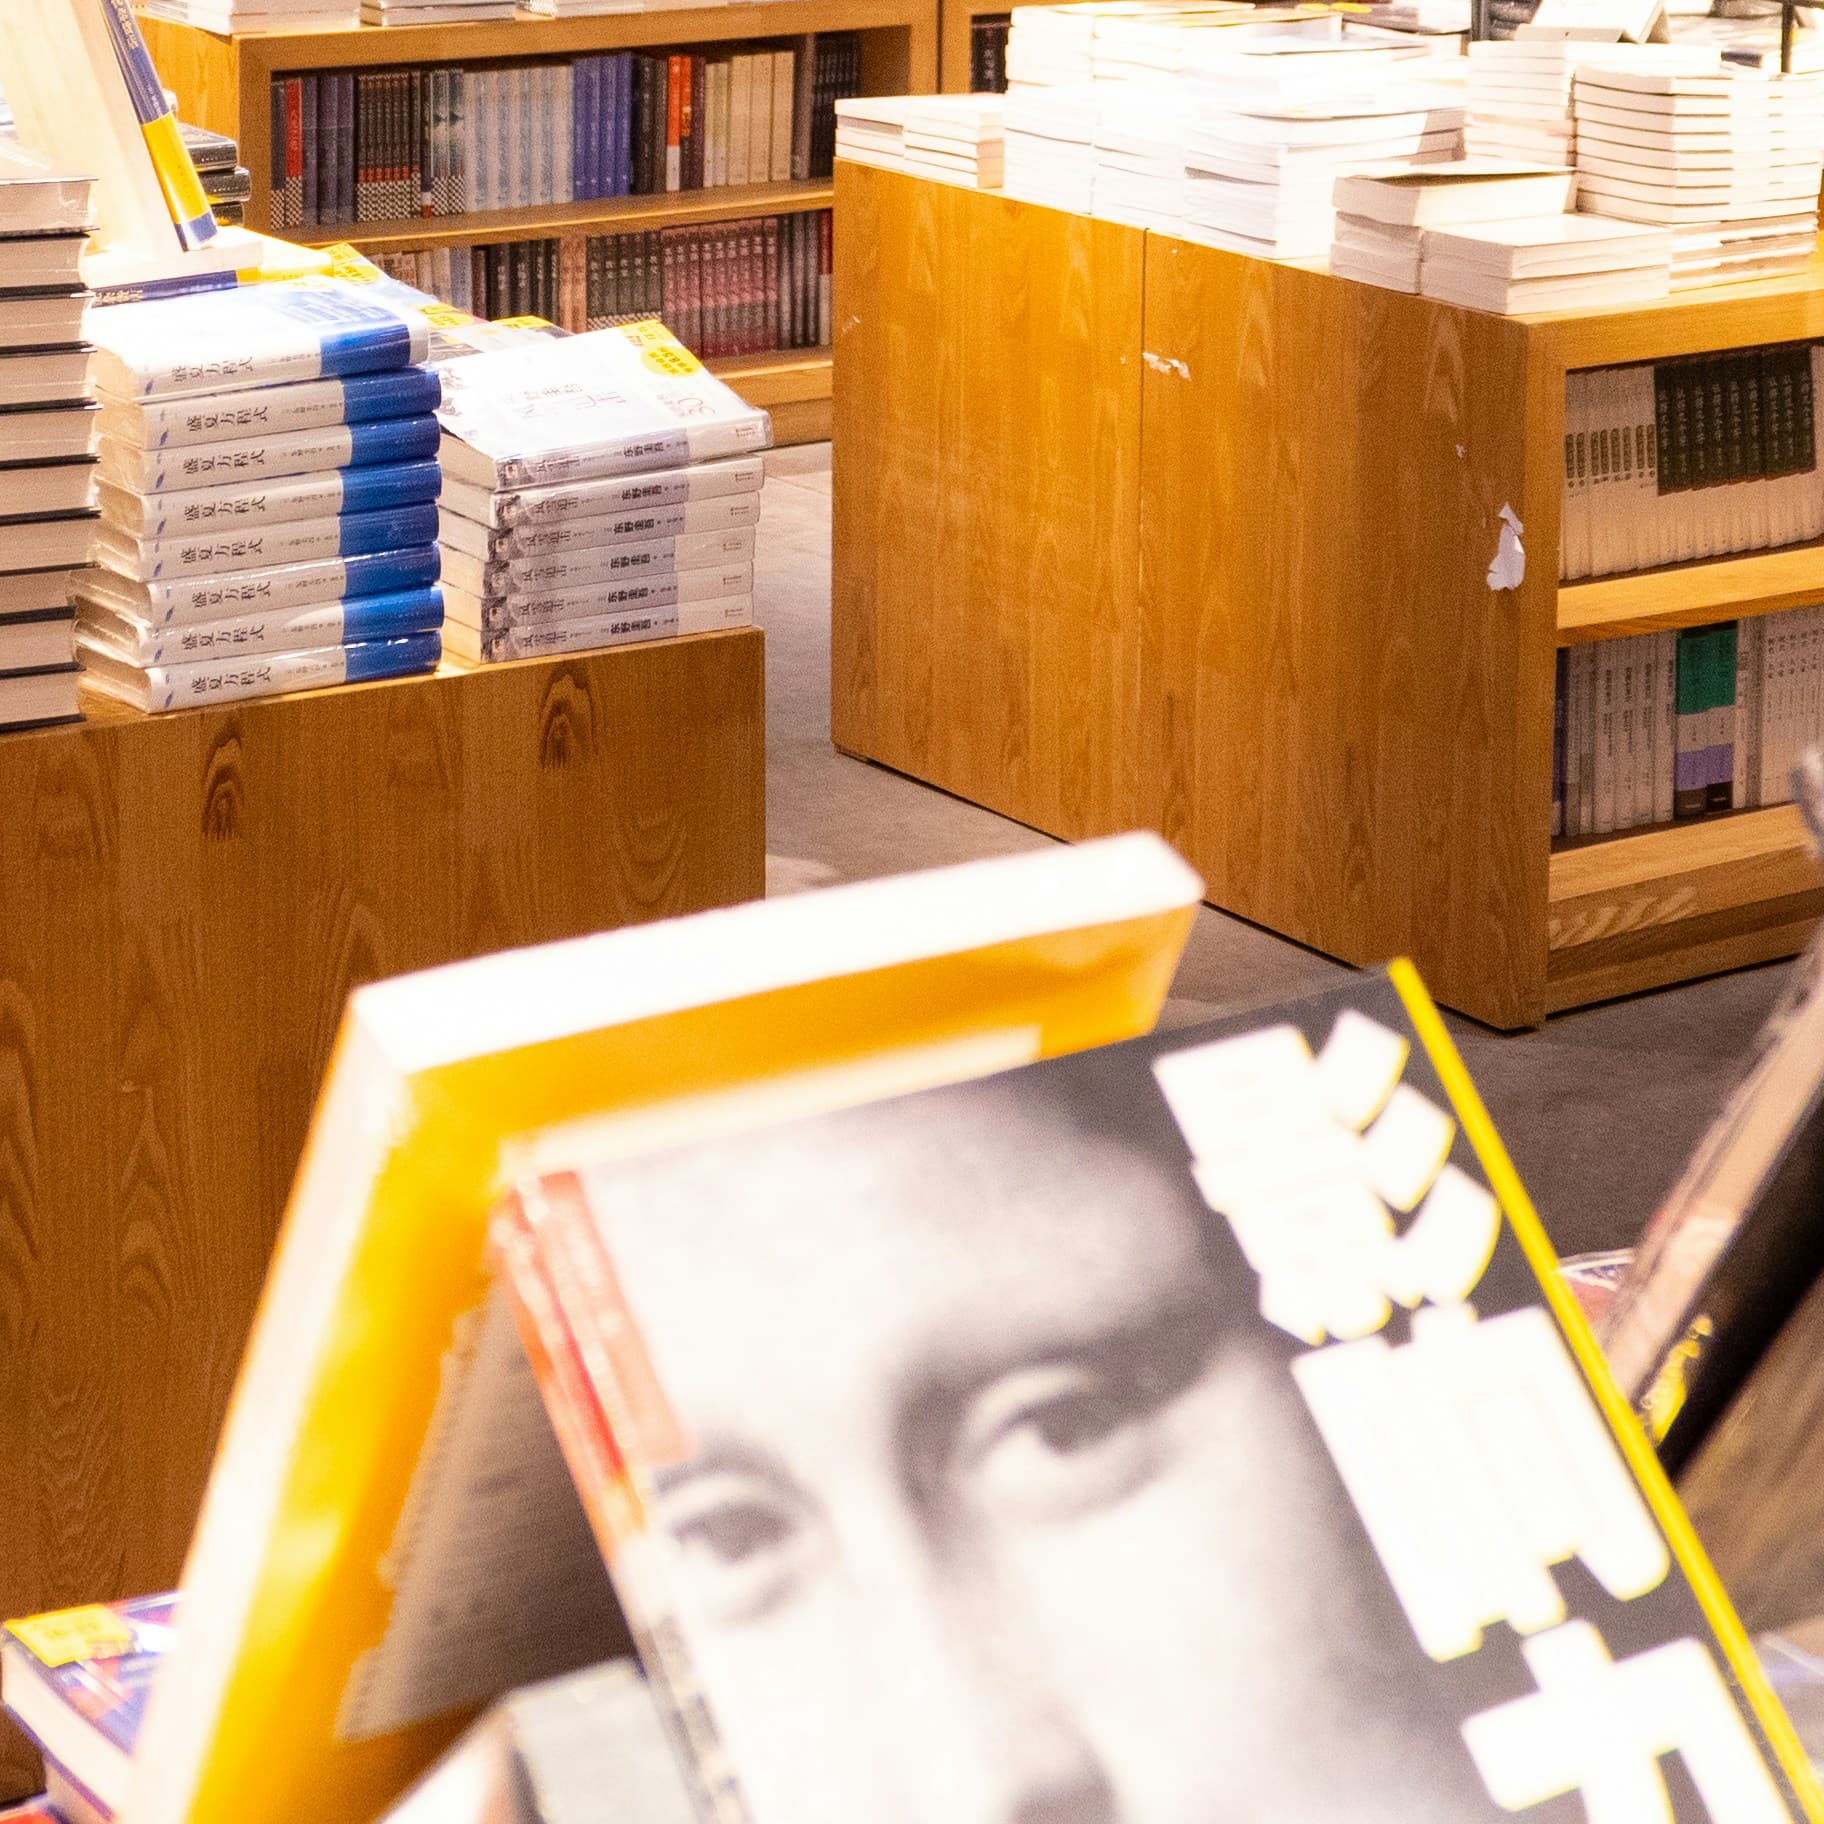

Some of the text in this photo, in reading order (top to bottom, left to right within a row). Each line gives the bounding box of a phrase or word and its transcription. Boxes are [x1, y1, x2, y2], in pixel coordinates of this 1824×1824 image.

[186, 406, 268, 432] 盛夏方程式
[182, 449, 265, 475] 盛夏方程式
[624, 441, 664, 457] 东野圭吾
[621, 484, 662, 502] 东野圭吾
[183, 495, 266, 522] 盛夏方程式
[613, 517, 655, 535] 东野圭吾
[181, 537, 263, 564] 盛夏方程式
[610, 553, 651, 570] 东野圭吾
[191, 580, 271, 608] 盛夏方程式
[608, 587, 649, 604] 东野圭吾
[181, 624, 265, 651] 盛夏方程式
[610, 617, 651, 635] 东野圭吾
[191, 666, 271, 694] 盛夏方程式
